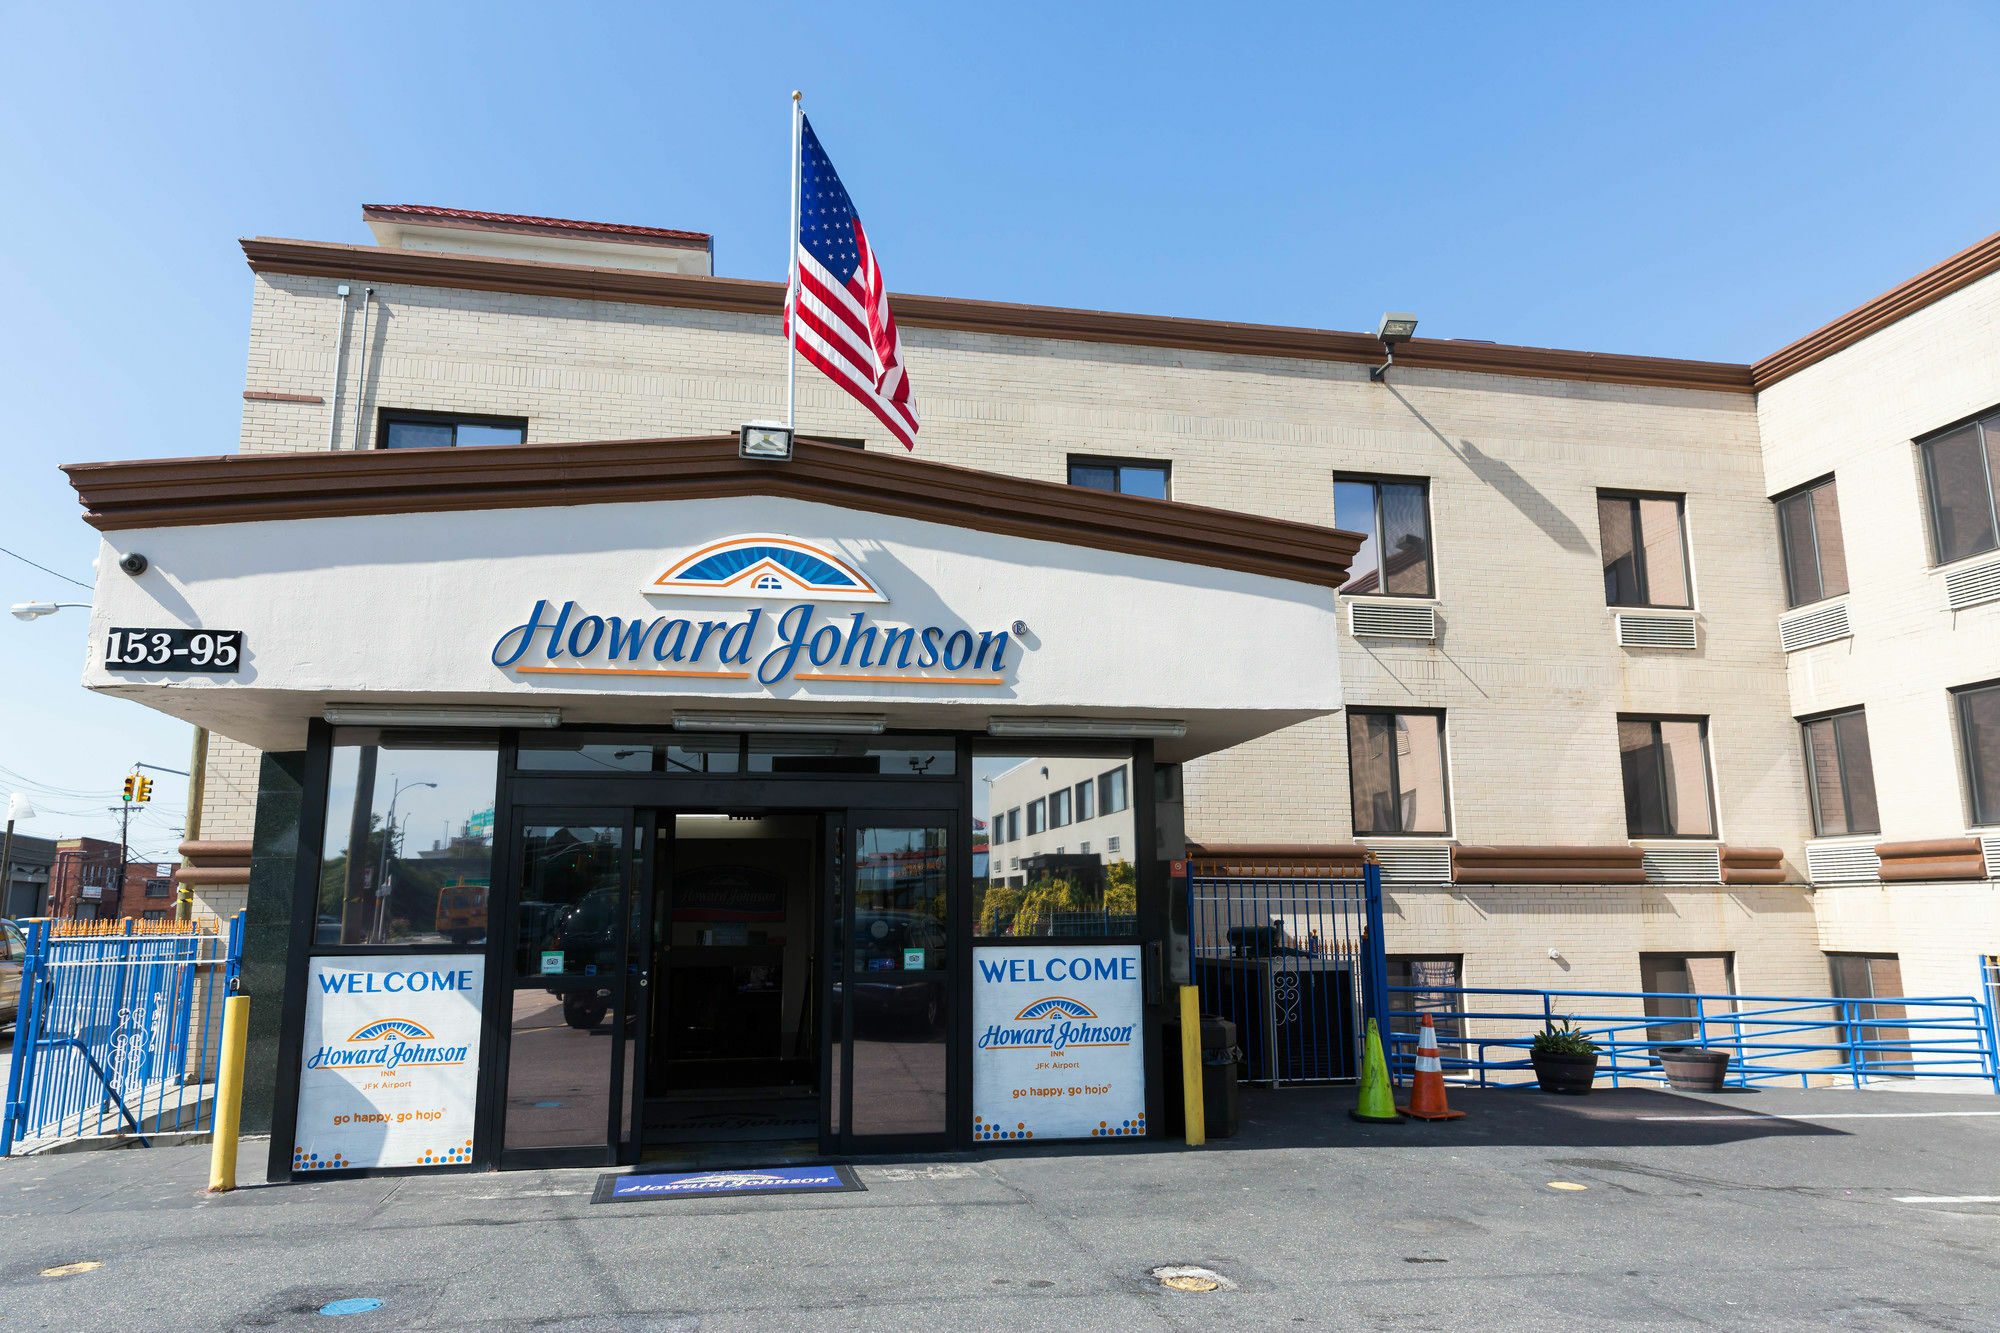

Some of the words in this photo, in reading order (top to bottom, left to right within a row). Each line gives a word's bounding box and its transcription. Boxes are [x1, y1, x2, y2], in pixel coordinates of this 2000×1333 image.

[105, 631, 238, 666] 153-95
[491, 600, 763, 668] Howard
[758, 604, 1008, 686] Johnson
[318, 970, 473, 994] WELCOME
[978, 957, 1137, 983] WELCOME
[978, 1023, 1055, 1049] Howard
[1054, 1021, 1132, 1050] Johnson
[307, 1044, 389, 1069] Howard
[387, 1041, 468, 1069] Johnson
[1034, 1062, 1050, 1070] JFK
[1051, 1061, 1080, 1070] Airport
[363, 1082, 379, 1091] JFK
[381, 1080, 412, 1089] Airport
[1012, 1088, 1027, 1098] go
[1029, 1086, 1065, 1097] happy.
[1067, 1086, 1083, 1096] go
[1084, 1083, 1109, 1095] hojo
[333, 1115, 350, 1125] go
[353, 1112, 394, 1124] happy.
[397, 1112, 413, 1123] go
[415, 1109, 442, 1122] hojo
[617, 1178, 727, 1193] Howard
[724, 1176, 830, 1189] Johnson
